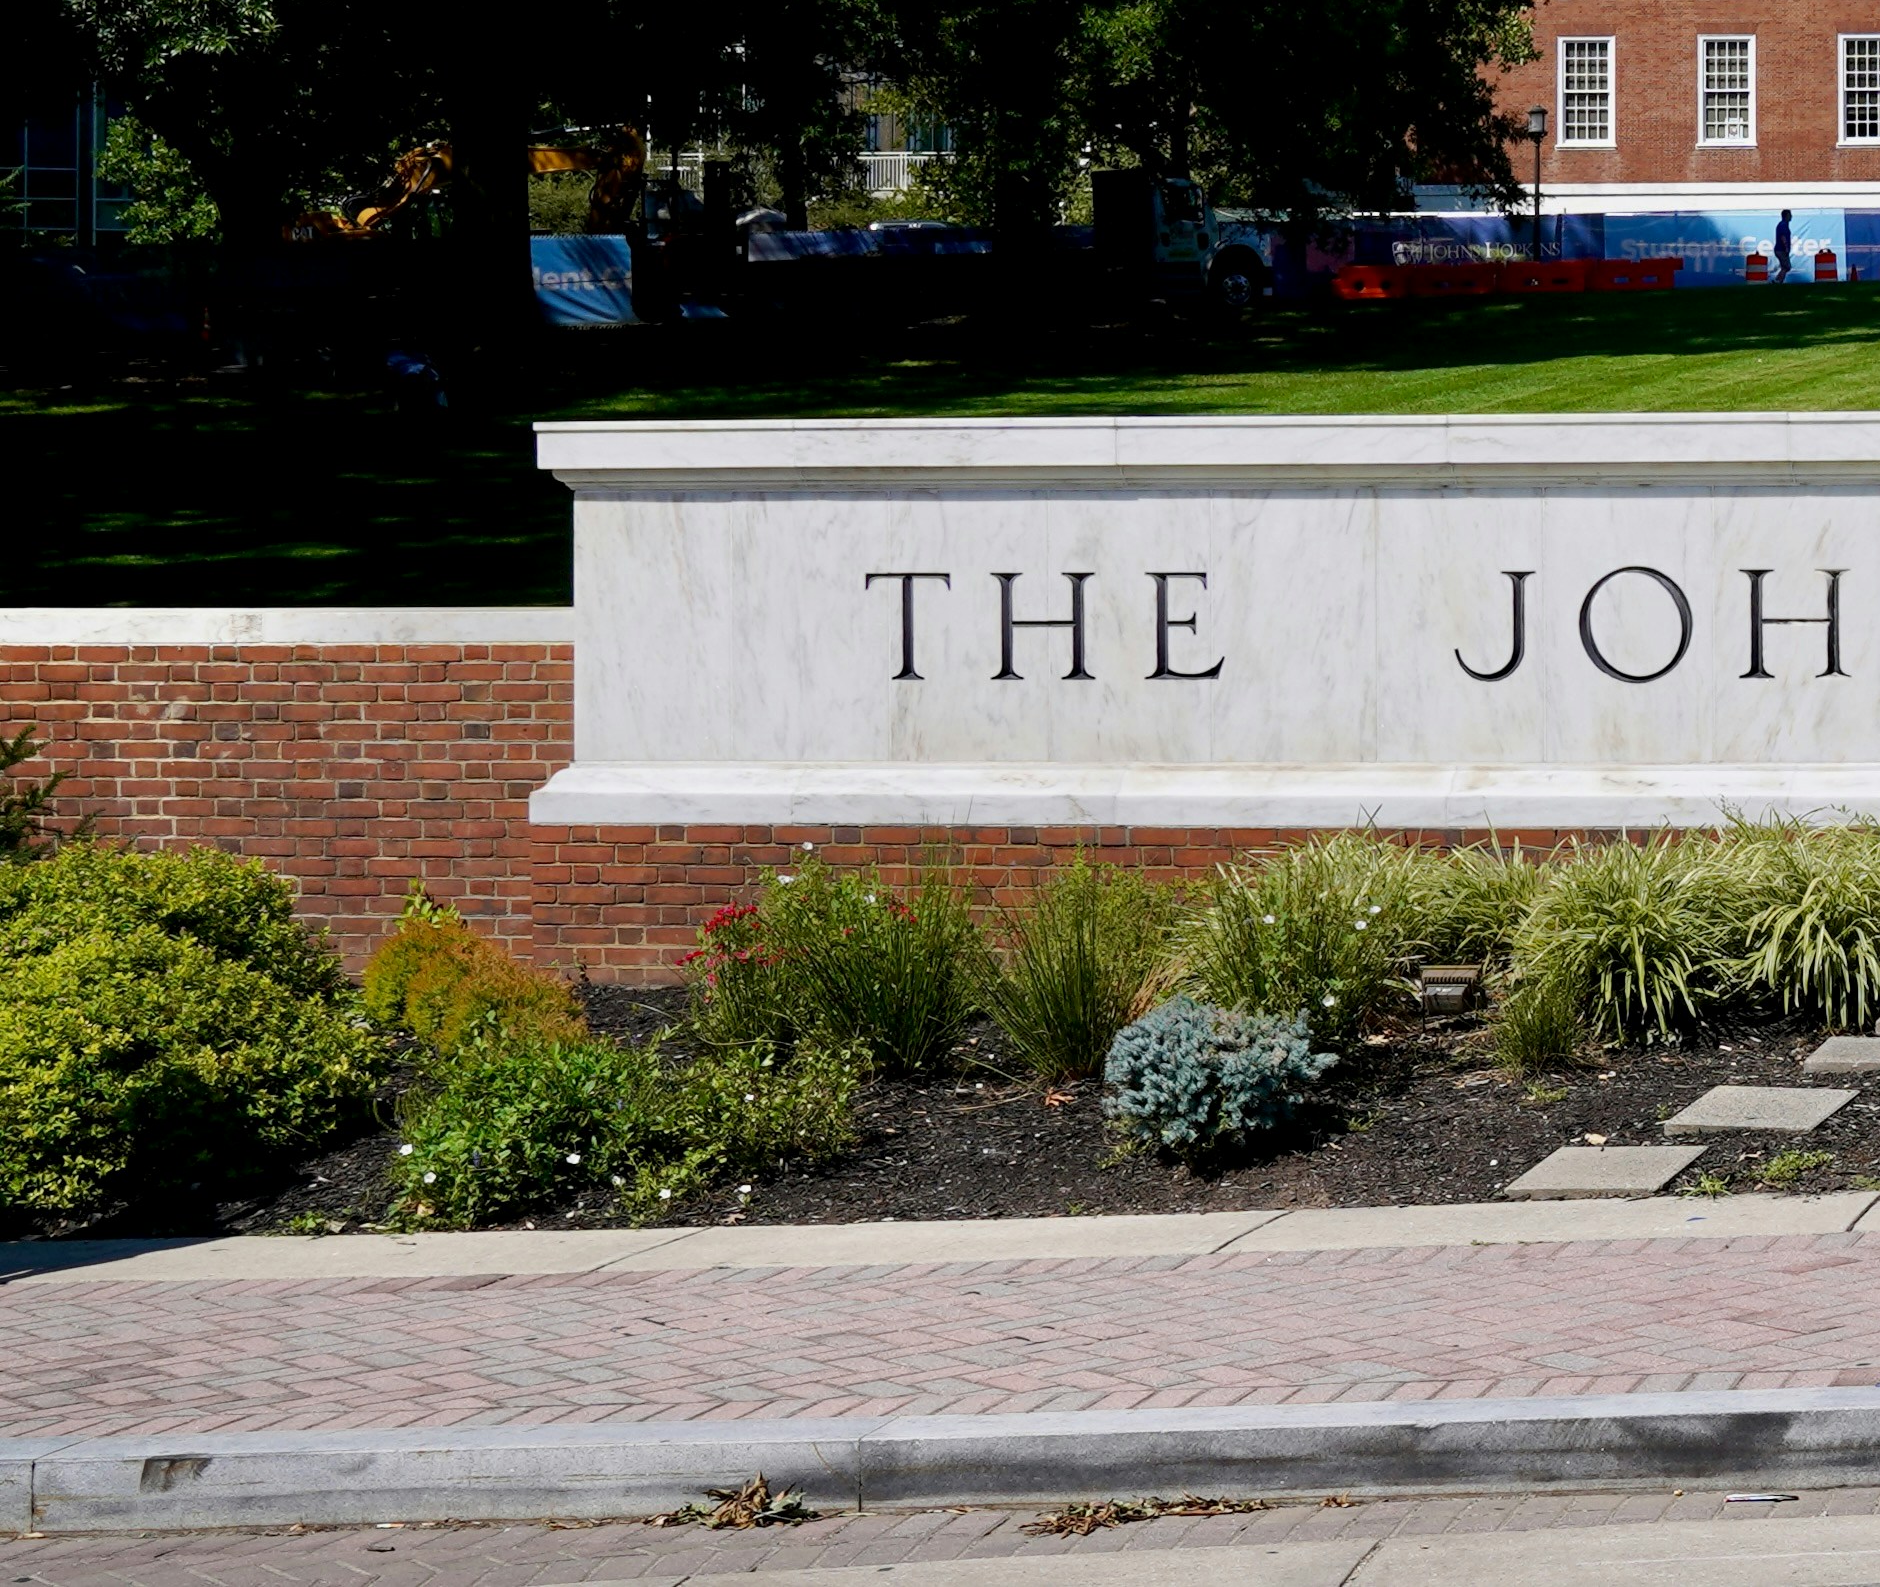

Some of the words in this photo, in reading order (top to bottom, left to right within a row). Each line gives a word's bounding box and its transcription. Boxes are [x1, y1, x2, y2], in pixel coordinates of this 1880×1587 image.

[1484, 241, 1561, 259] HOPKNS
[1738, 235, 1832, 257] Ceter
[864, 571, 1226, 682] THE
